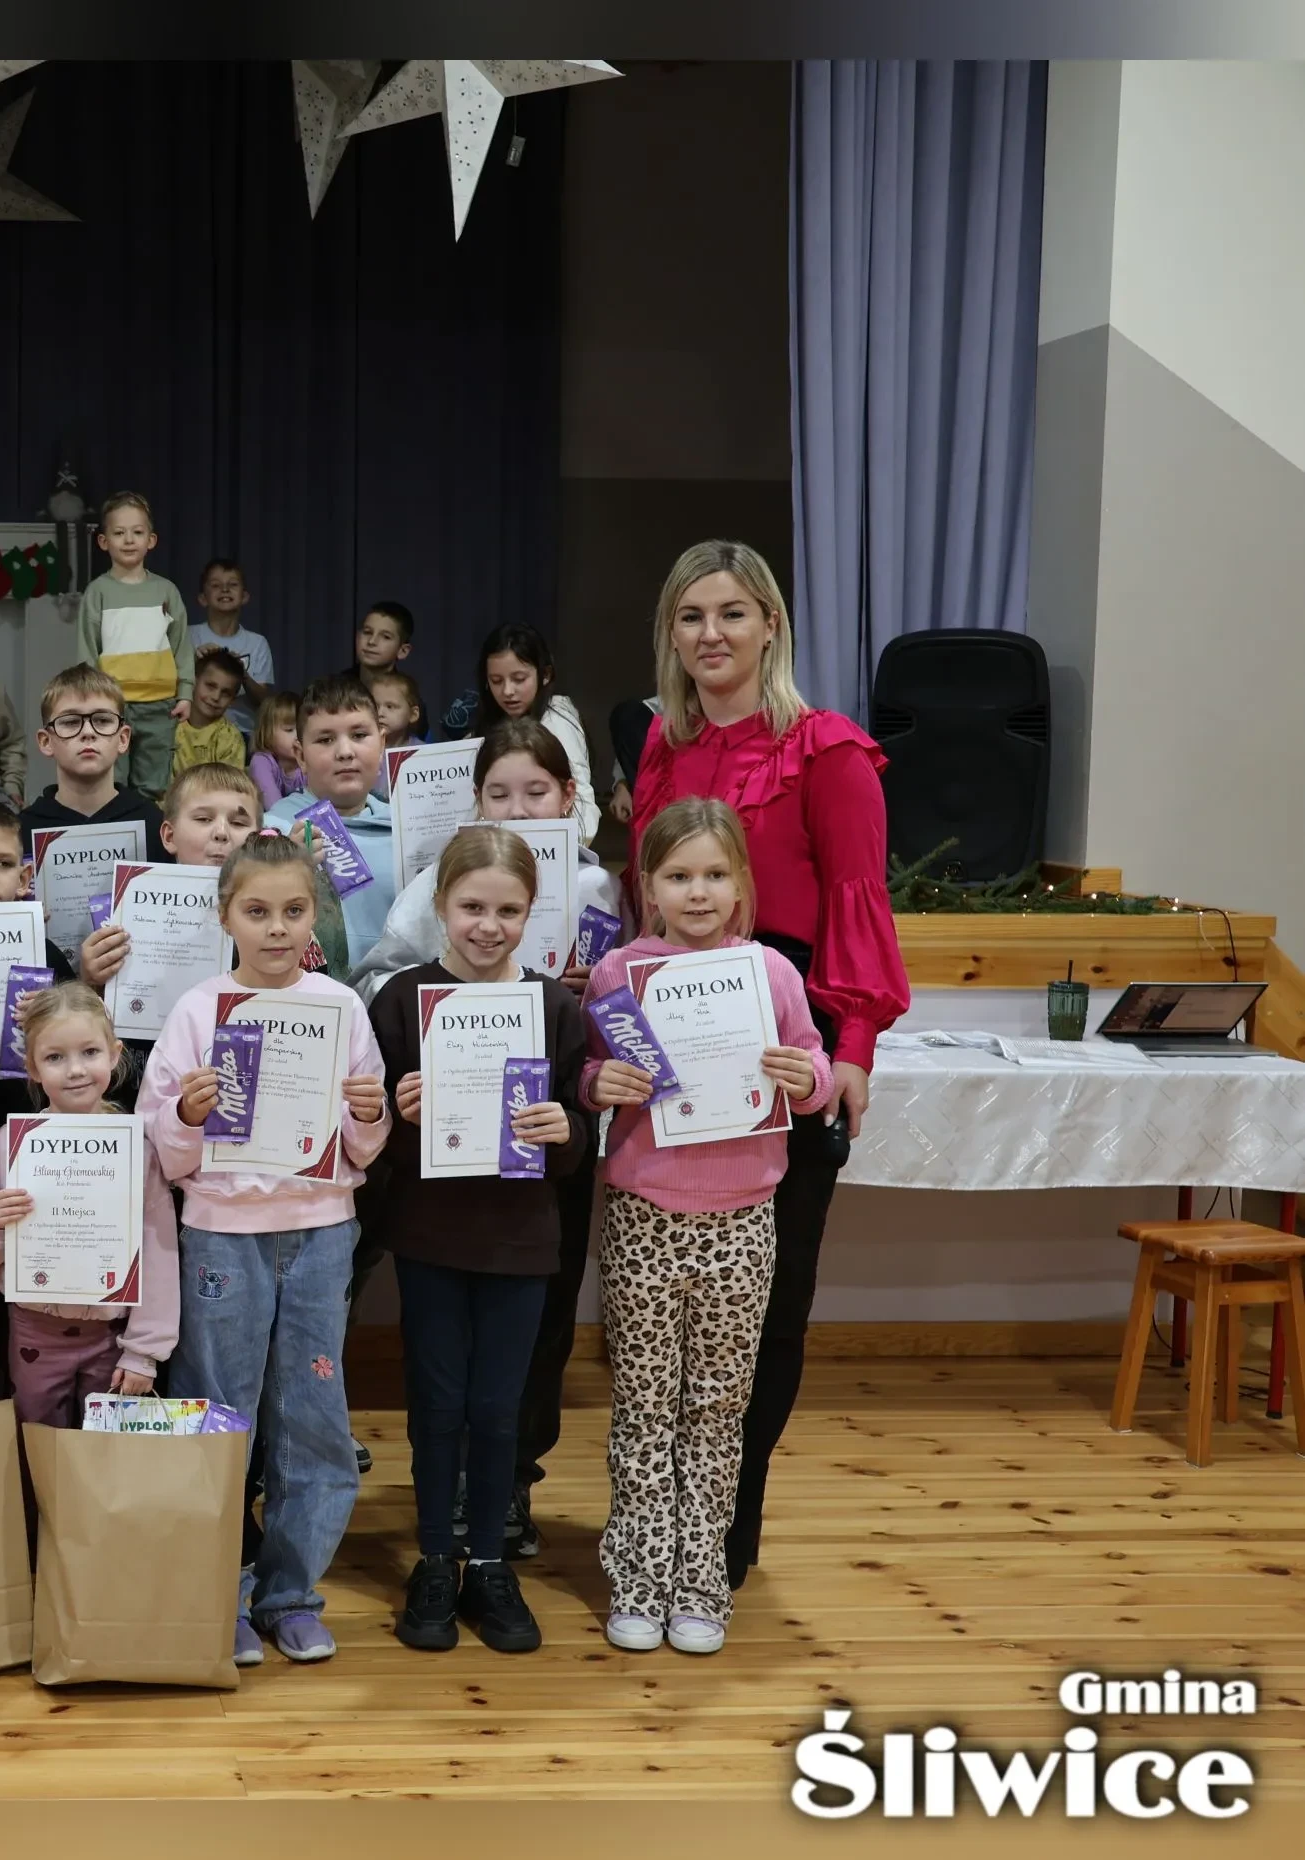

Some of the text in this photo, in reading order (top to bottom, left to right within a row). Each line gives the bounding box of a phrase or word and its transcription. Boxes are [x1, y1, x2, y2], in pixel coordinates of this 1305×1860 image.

[406, 765, 471, 785] DYPLOM
[53, 847, 128, 866] DYPLOM
[133, 890, 215, 909] DYPLOM
[655, 976, 744, 1003] DYPLOM
[442, 1013, 523, 1031] DYPLOM
[606, 1013, 662, 1077] Milka
[216, 1048, 248, 1123] Milka
[30, 1138, 119, 1154] DYPLOM
[52, 1206, 96, 1219] II Miejsca
